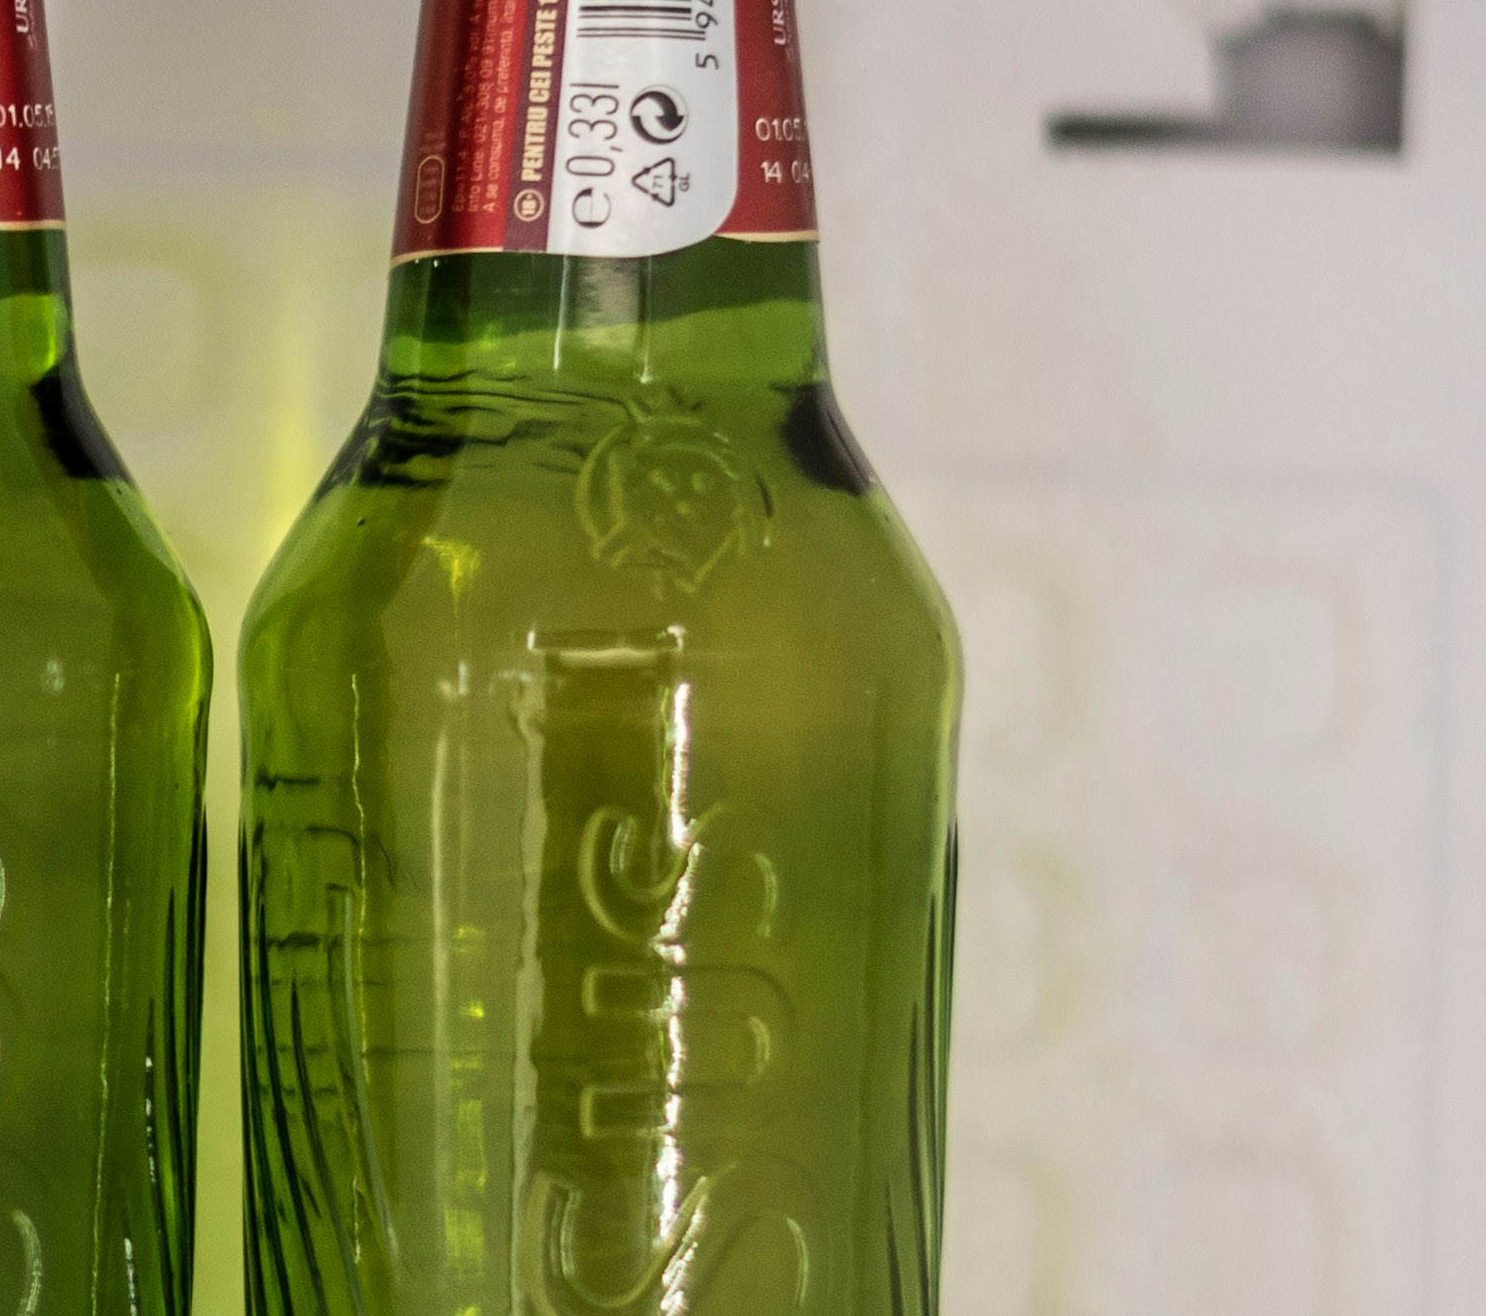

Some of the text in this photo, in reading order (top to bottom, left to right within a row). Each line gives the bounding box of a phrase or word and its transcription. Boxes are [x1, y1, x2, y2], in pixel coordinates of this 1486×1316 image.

[532, 9, 556, 66] PESTE
[530, 71, 551, 102] CEI
[521, 108, 546, 181] PENTRU
[565, 83, 623, 177] 0,33l
[761, 161, 782, 183] 14
